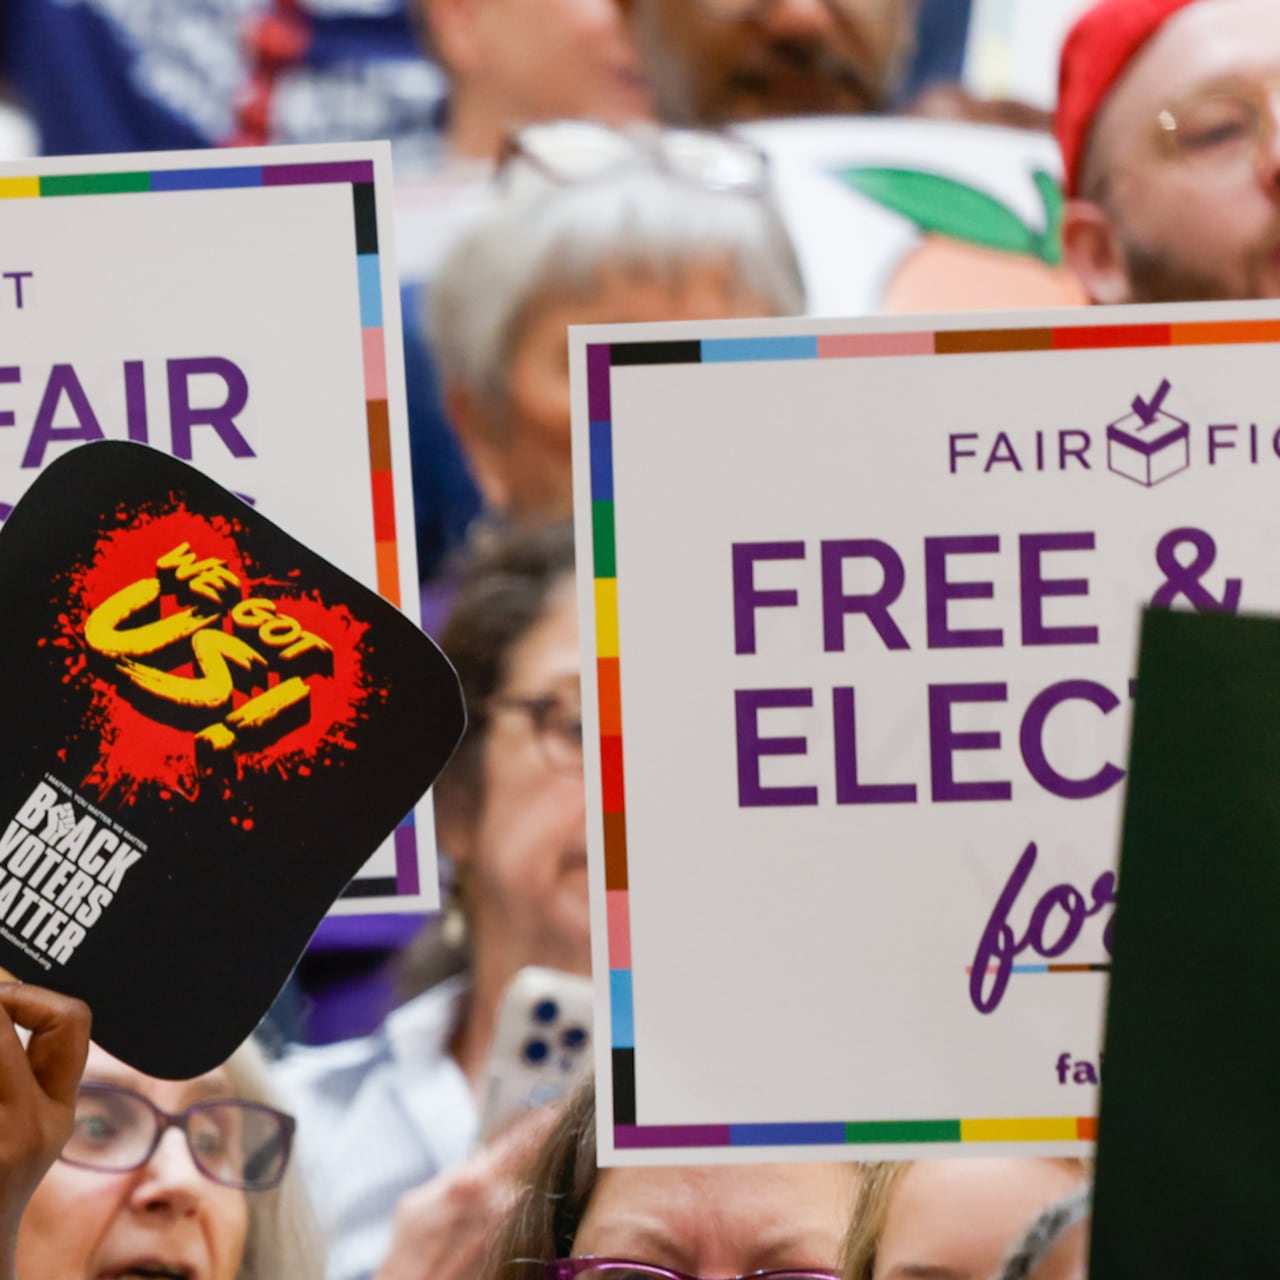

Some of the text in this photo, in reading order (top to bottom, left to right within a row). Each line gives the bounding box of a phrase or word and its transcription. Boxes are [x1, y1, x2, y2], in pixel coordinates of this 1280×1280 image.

[947, 423, 1280, 475] FAIR FI
[156, 541, 333, 660] WE GOT
[731, 527, 1243, 656] FREE &
[84, 577, 311, 750] US!
[734, 676, 1137, 809] ELEC
[1055, 1052, 1103, 1086] fa
